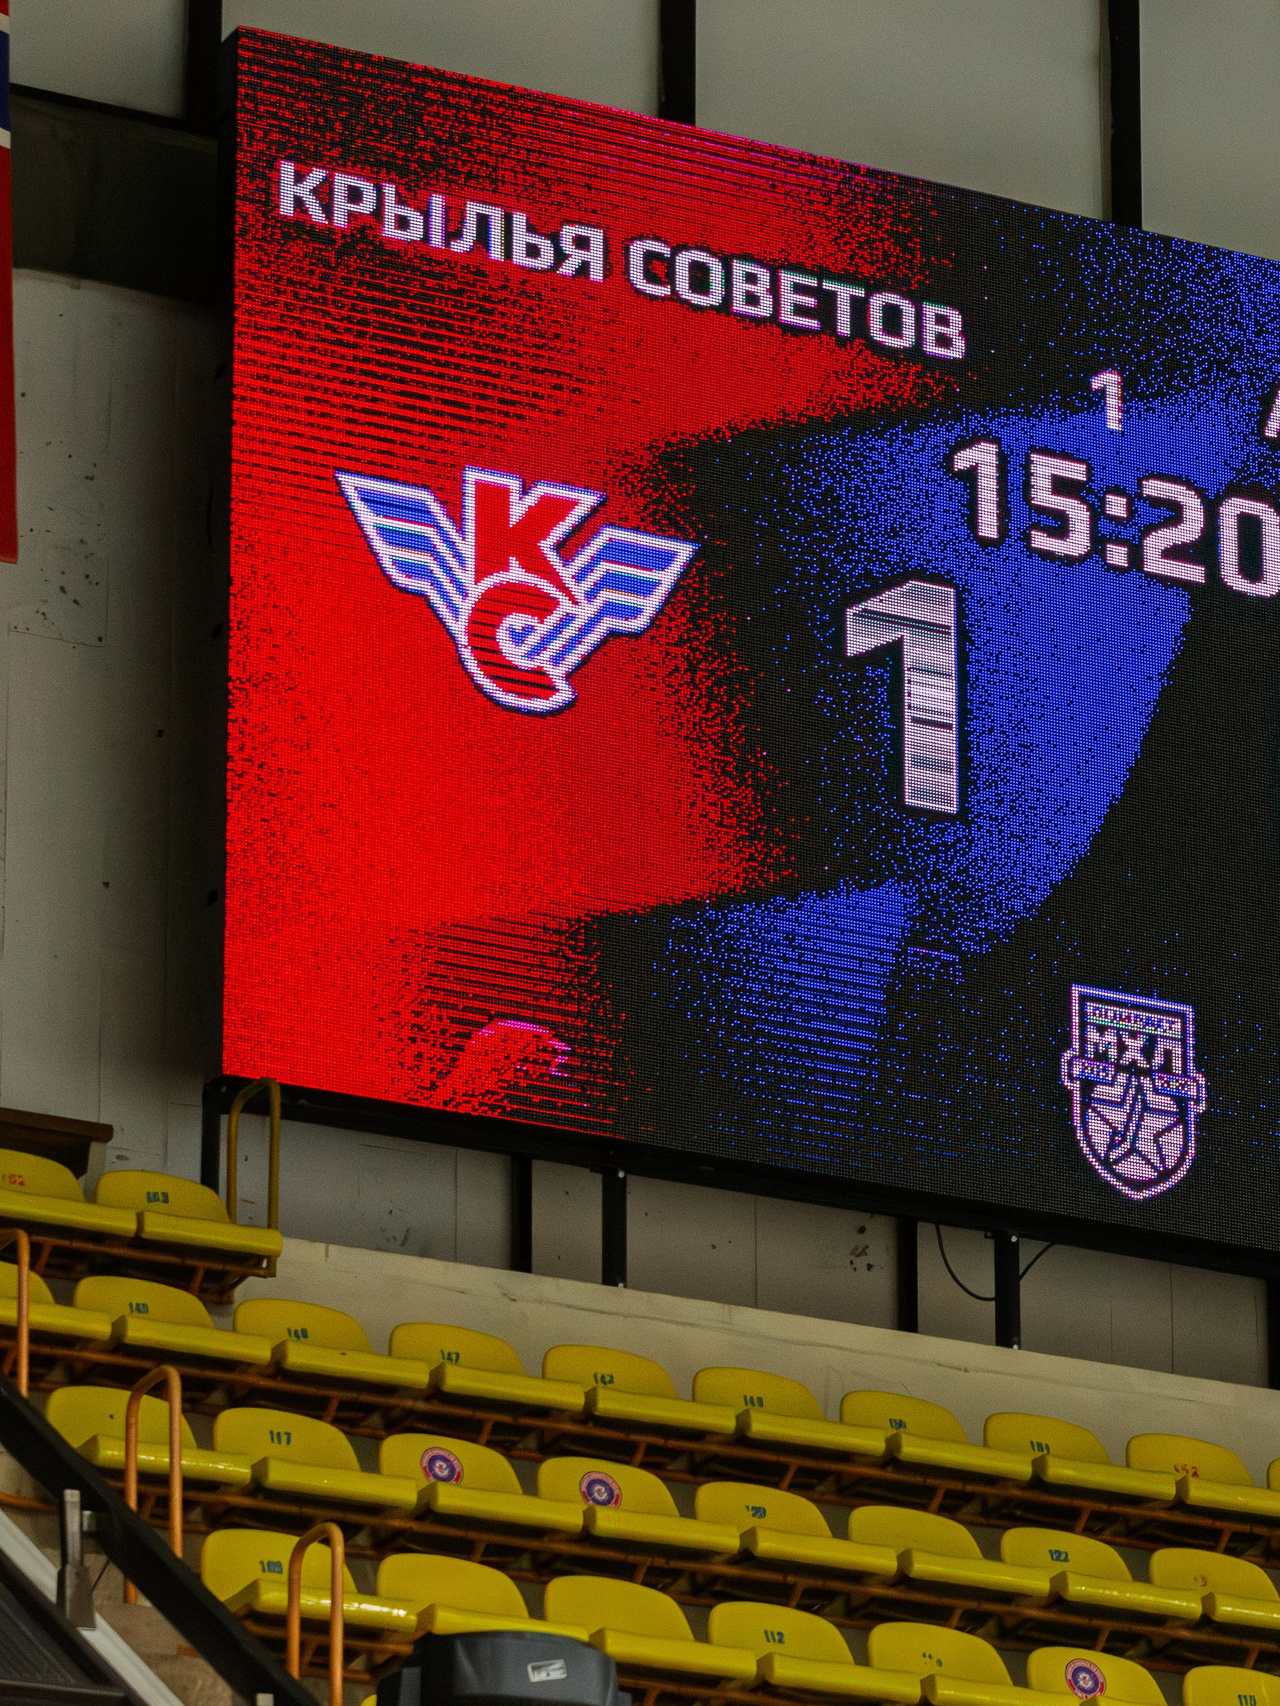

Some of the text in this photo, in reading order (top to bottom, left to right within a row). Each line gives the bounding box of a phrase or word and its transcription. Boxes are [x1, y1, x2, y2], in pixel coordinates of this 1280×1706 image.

[278, 159, 966, 361] КРЫЛЬЯ СОВЕТОВ
[1090, 369, 1124, 432] 1
[845, 579, 959, 816] 1
[1084, 1024, 1183, 1075] МХЛ
[763, 1629, 786, 1645] 112
